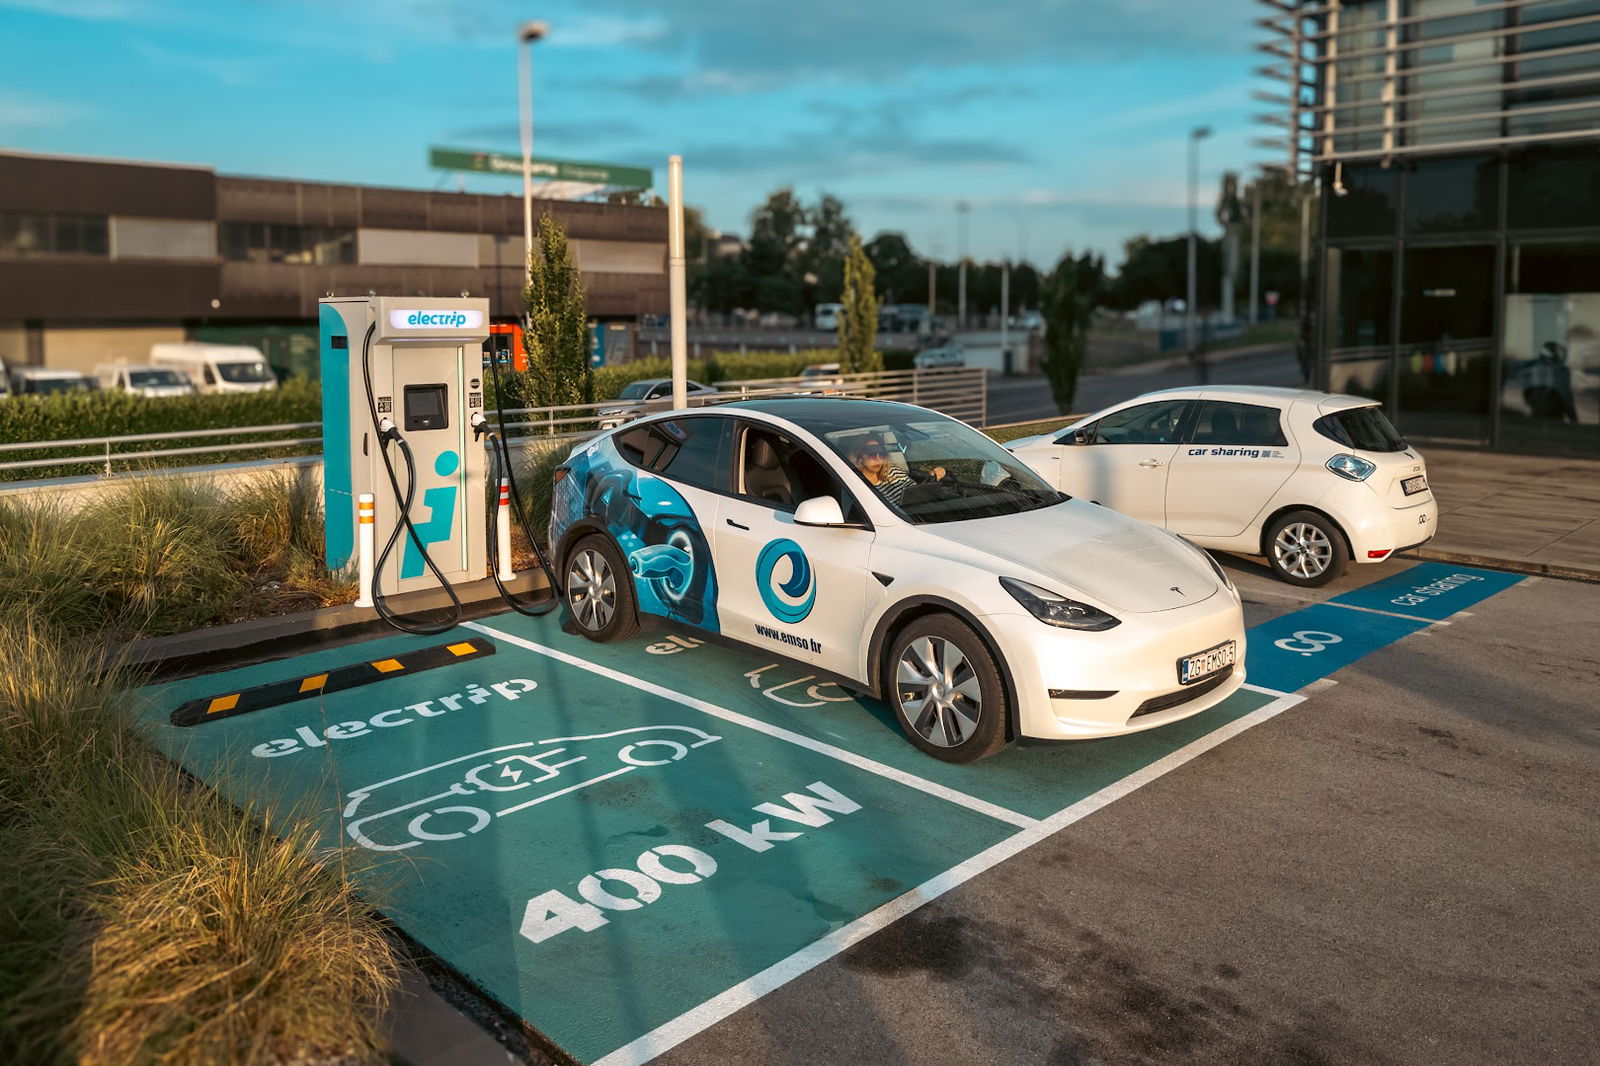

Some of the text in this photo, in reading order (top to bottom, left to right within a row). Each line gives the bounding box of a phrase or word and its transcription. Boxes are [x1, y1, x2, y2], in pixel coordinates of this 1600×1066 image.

[408, 311, 466, 327] electrip
[1188, 447, 1260, 458] car sharing
[1391, 573, 1485, 606] car sharing
[1190, 659, 1201, 678] ZG
[251, 678, 539, 758] electrip
[519, 781, 863, 944] 400 kW
